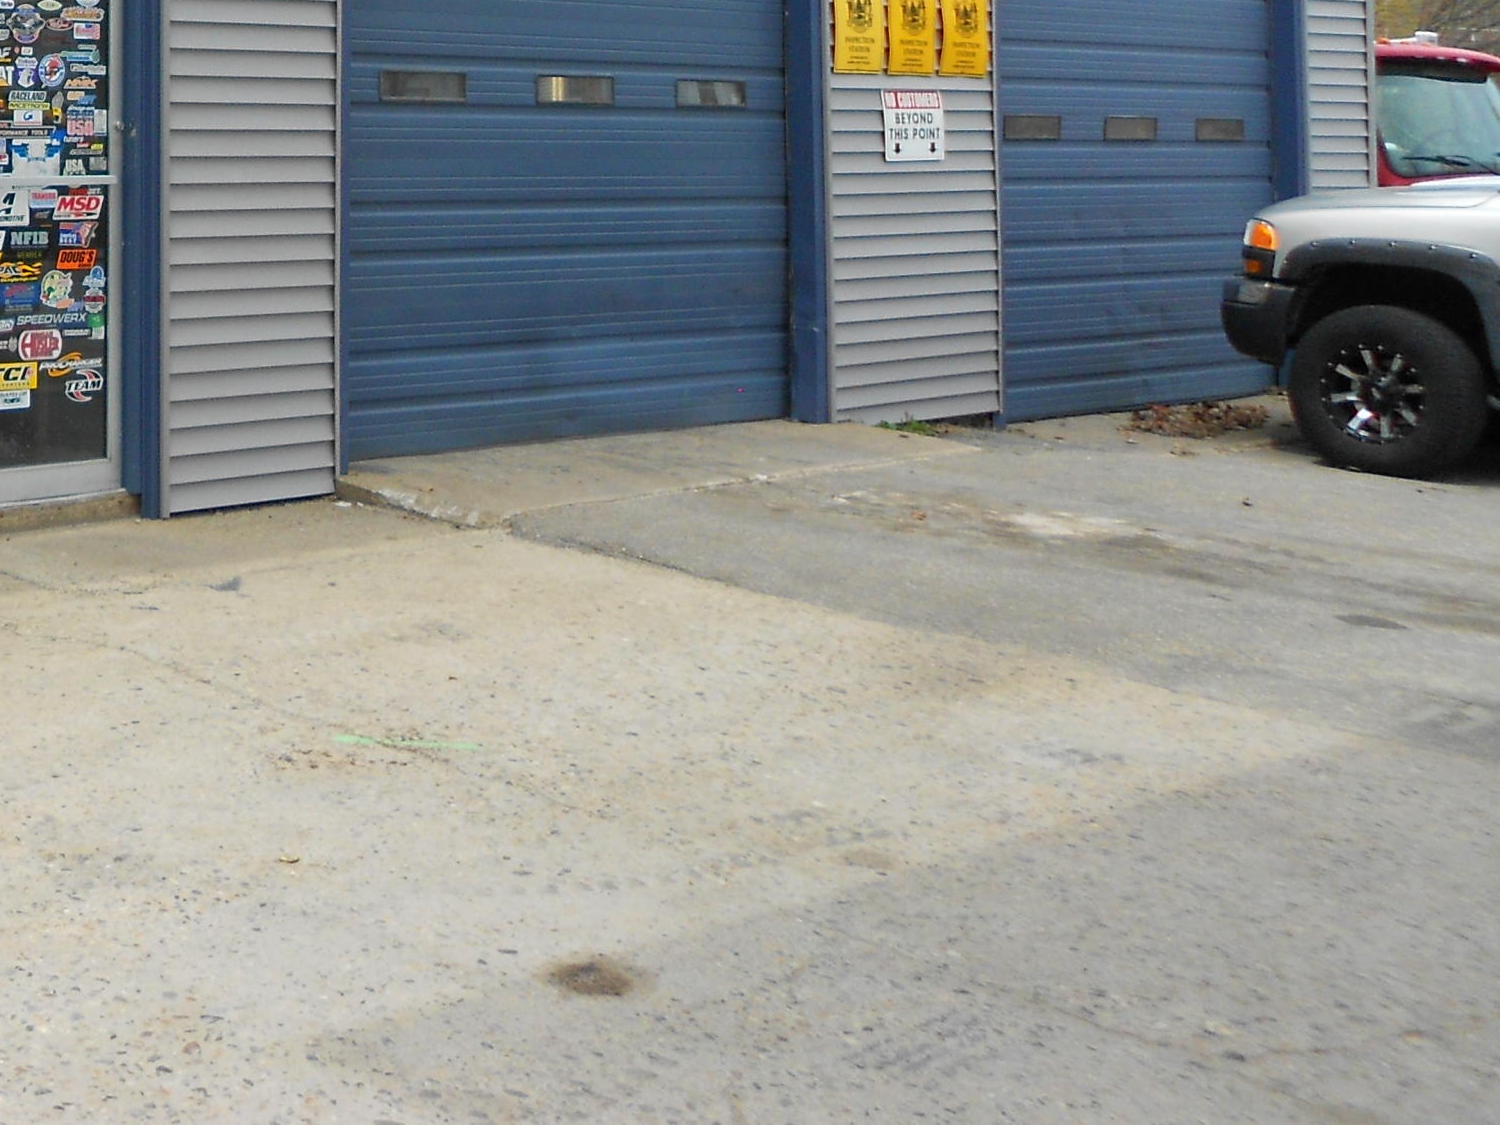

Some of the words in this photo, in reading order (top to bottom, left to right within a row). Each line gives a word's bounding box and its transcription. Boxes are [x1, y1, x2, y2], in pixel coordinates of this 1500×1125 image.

[11, 90, 45, 101] RACELAND
[895, 112, 933, 124] BEYOND
[889, 128, 909, 140] THIS
[912, 127, 940, 140] POINT
[57, 196, 100, 211] MSD
[11, 231, 49, 245] NFIB
[60, 251, 95, 263] DOUG'S
[16, 313, 87, 326] SPEEDWERX
[67, 380, 101, 391] TEAM
